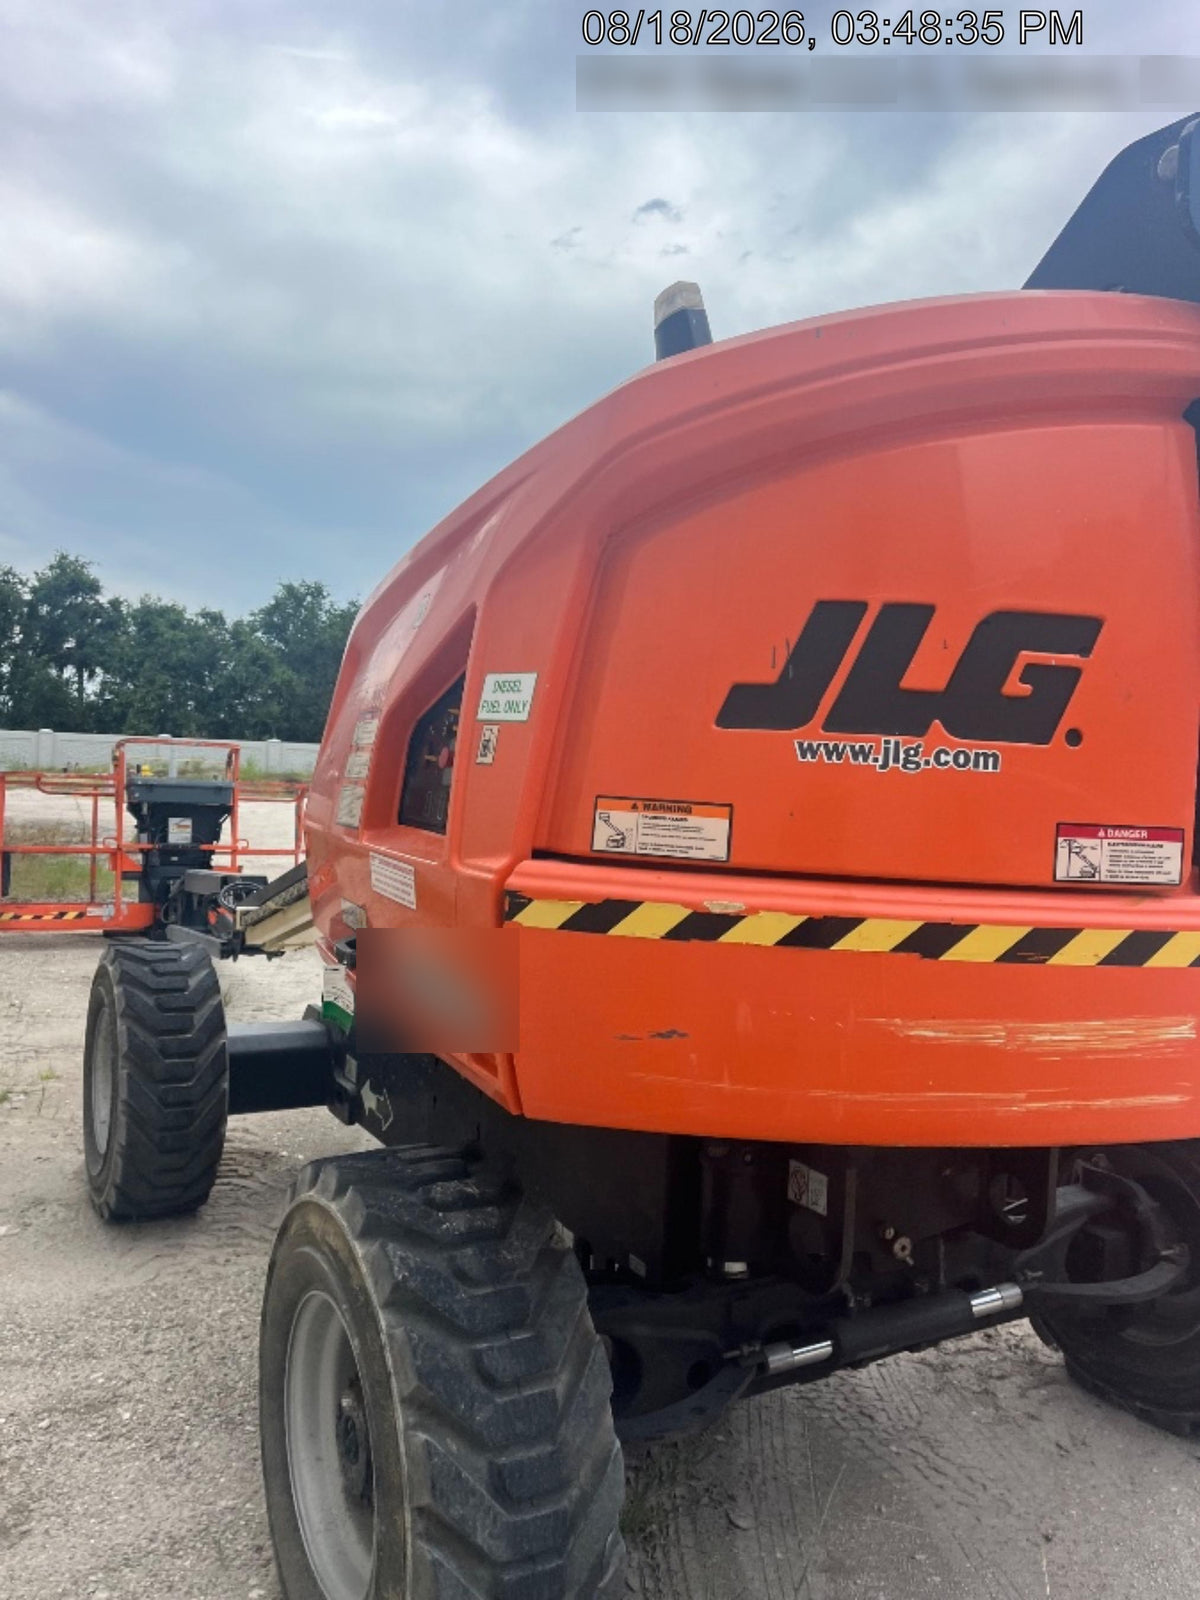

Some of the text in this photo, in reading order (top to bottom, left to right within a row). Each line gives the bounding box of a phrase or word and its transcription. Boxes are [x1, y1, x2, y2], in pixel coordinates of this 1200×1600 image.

[492, 679, 523, 694] DIESEL
[481, 700, 529, 714] FUEL ONLY
[794, 738, 1002, 772] www.jlg.com
[642, 802, 693, 815] WARNING
[1107, 829, 1148, 839] DANGER
